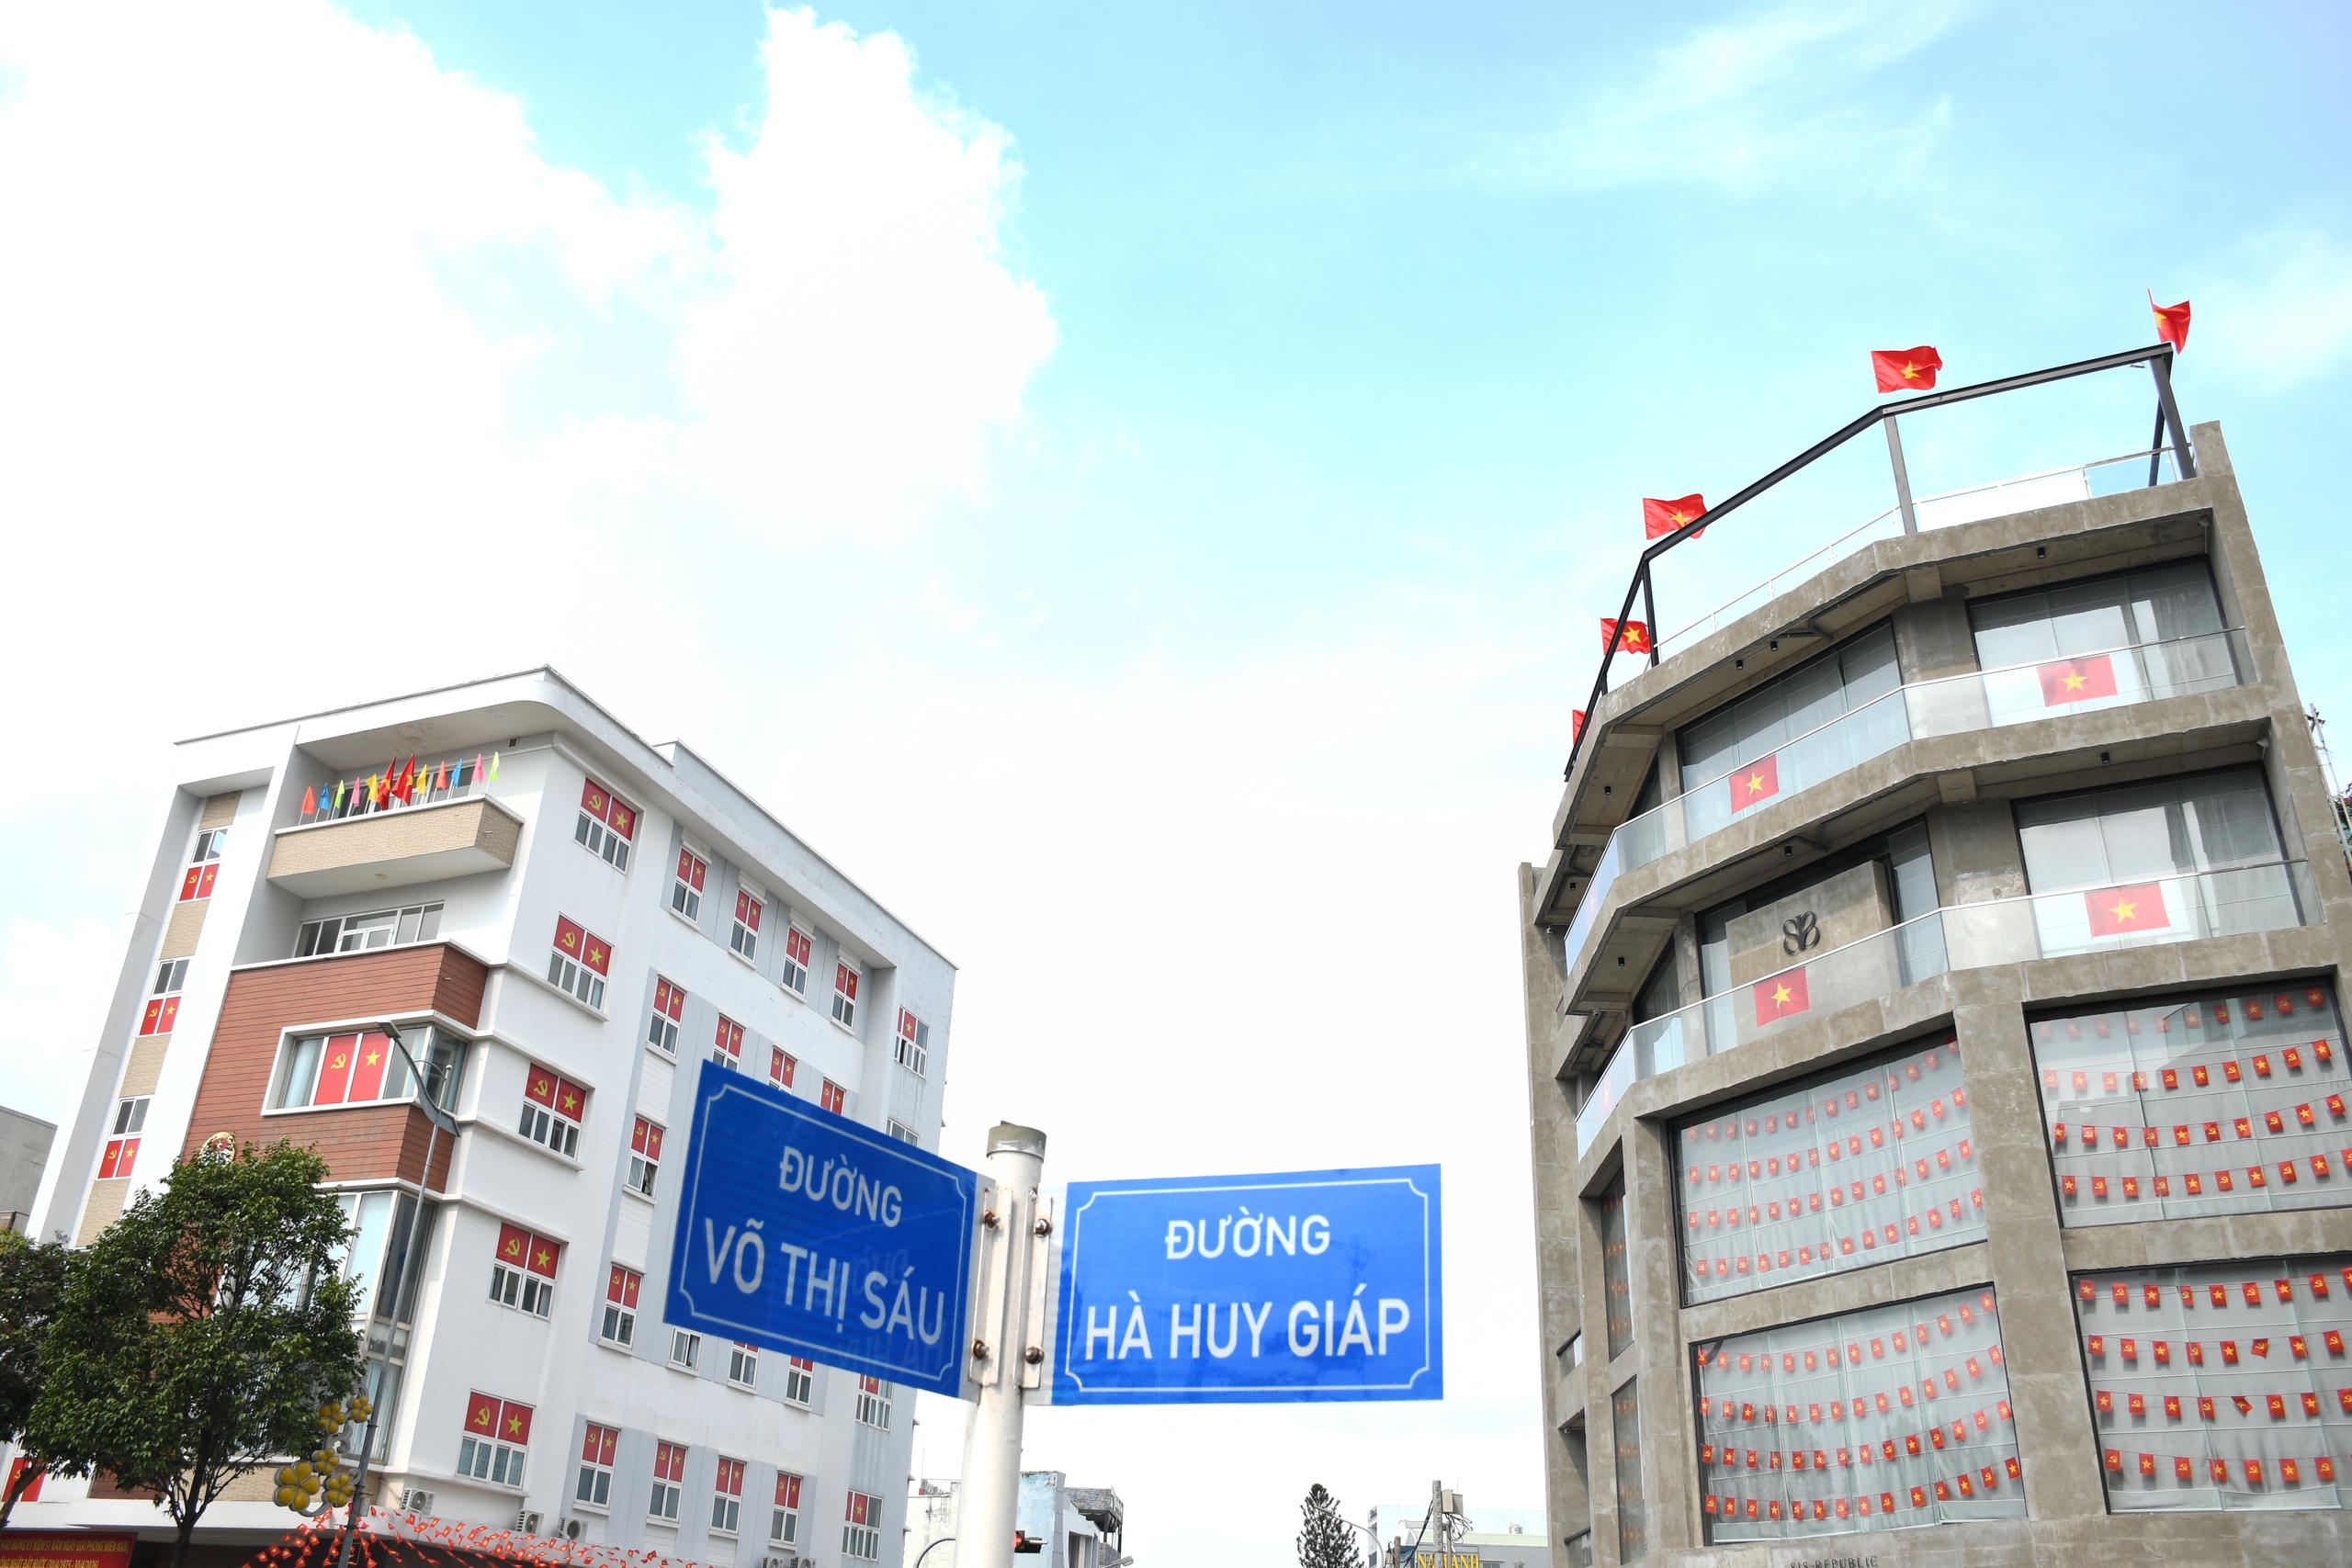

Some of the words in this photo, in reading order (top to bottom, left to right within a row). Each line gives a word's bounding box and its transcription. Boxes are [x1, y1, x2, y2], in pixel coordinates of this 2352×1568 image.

[779, 1145, 902, 1227] ĐƯỜNG
[1164, 1206, 1330, 1259] ĐƯỜNG
[705, 1218, 764, 1293] VÕ
[781, 1243, 850, 1334] THỊ
[860, 1280, 945, 1345] SÁU
[1085, 1290, 1154, 1360] HÀ
[1170, 1302, 1273, 1359] HUY
[1288, 1282, 1411, 1358] GIÁP
